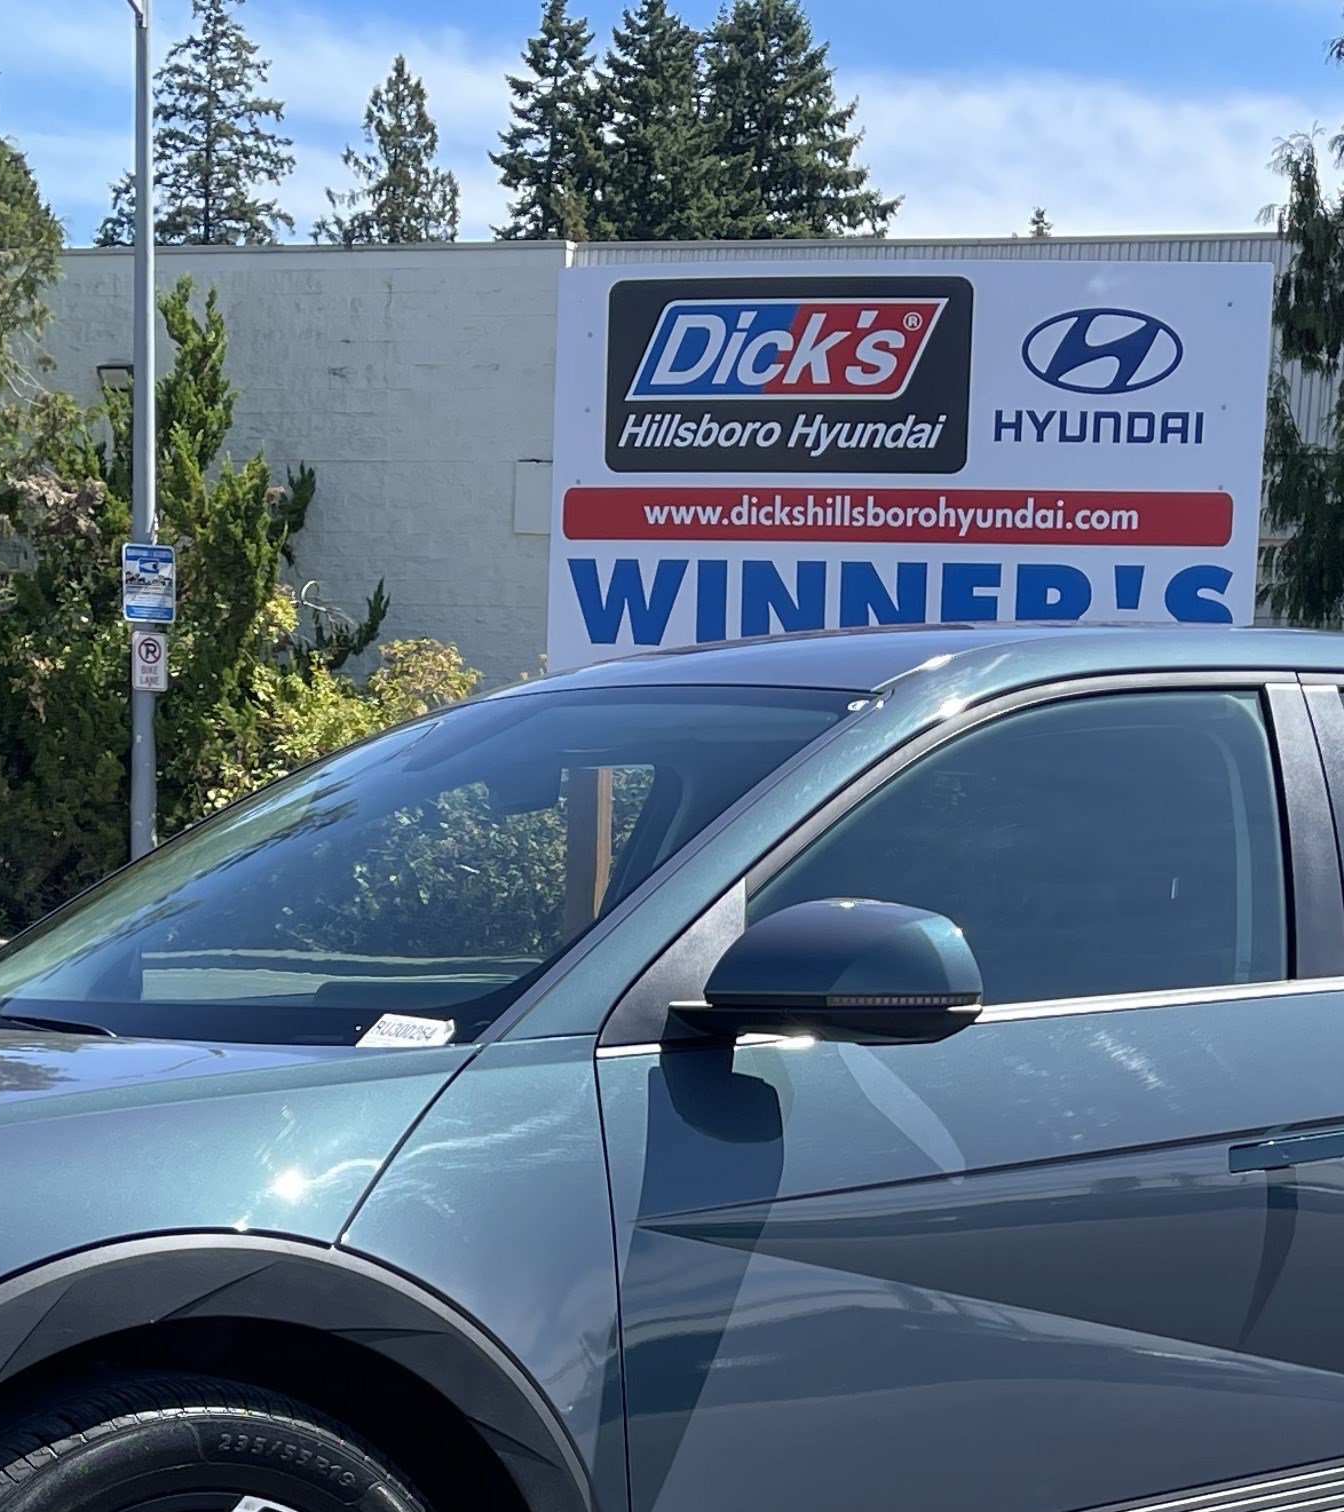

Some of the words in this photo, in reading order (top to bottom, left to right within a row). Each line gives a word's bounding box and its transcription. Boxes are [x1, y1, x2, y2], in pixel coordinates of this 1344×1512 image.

[617, 413, 782, 449] Hillsboro
[787, 413, 948, 458] Hyundai
[994, 409, 1204, 445] HYUNDAI
[643, 494, 1140, 537] www.dickshillsborohyundai.com
[566, 558, 1234, 646] WINNER'S
[140, 676, 159, 686] LANE
